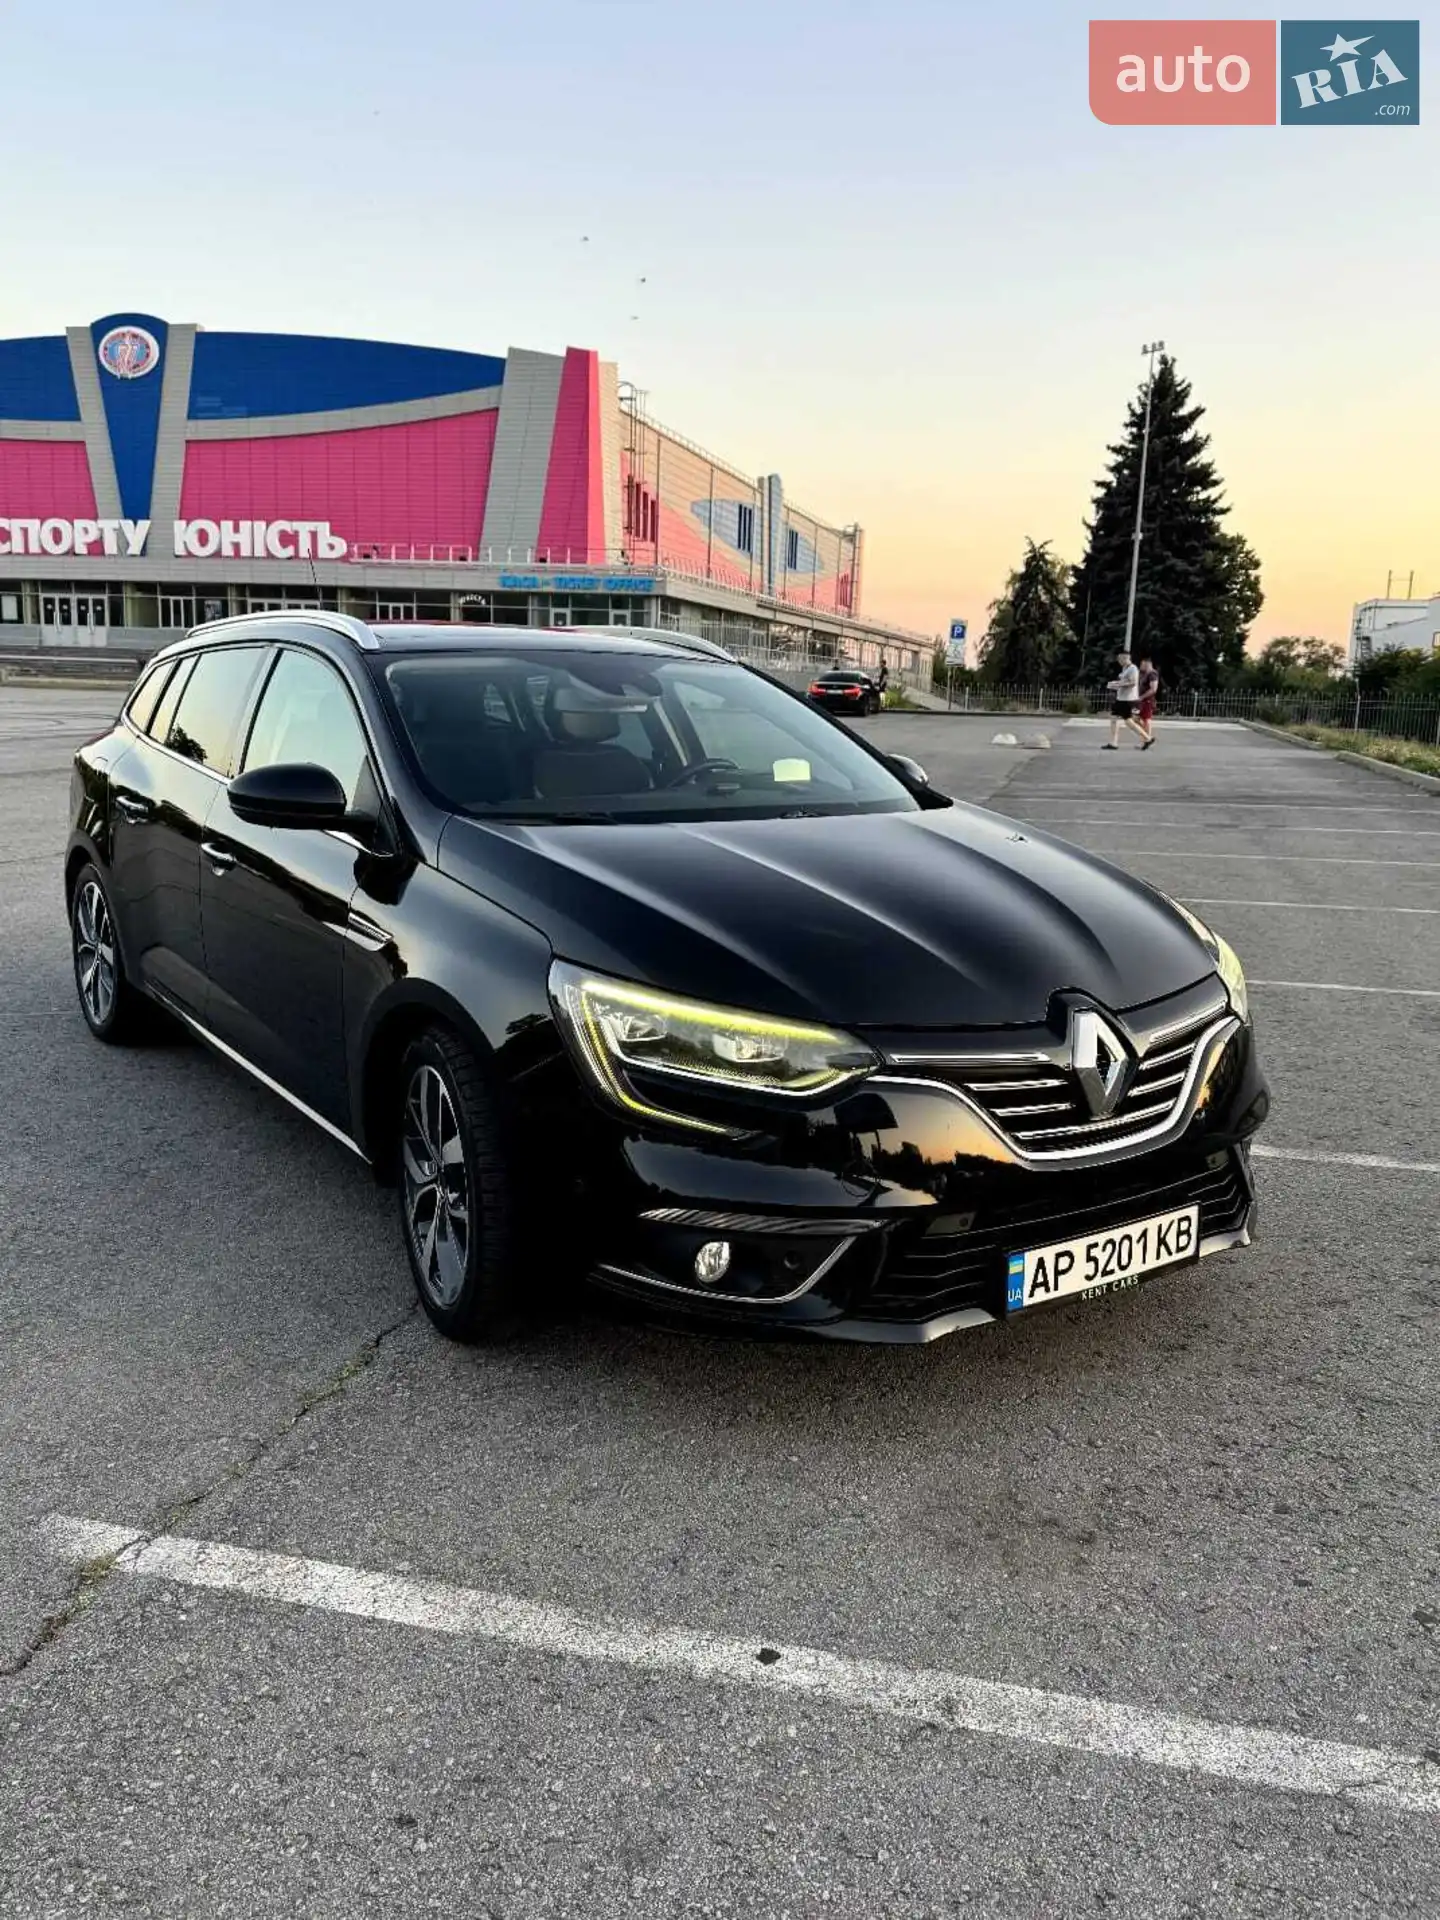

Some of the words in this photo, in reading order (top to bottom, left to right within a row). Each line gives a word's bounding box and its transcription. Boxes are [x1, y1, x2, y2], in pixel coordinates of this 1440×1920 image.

[174, 519, 348, 559] ЮНІСТЬ
[954, 626, 963, 637] P
[1028, 1250, 1075, 1298] AP
[1084, 1227, 1149, 1281] 5201
[1155, 1215, 1193, 1261] KB
[1007, 1288, 1023, 1302] UA
[1081, 1284, 1108, 1301] KENT
[1112, 1274, 1139, 1292] CARS
